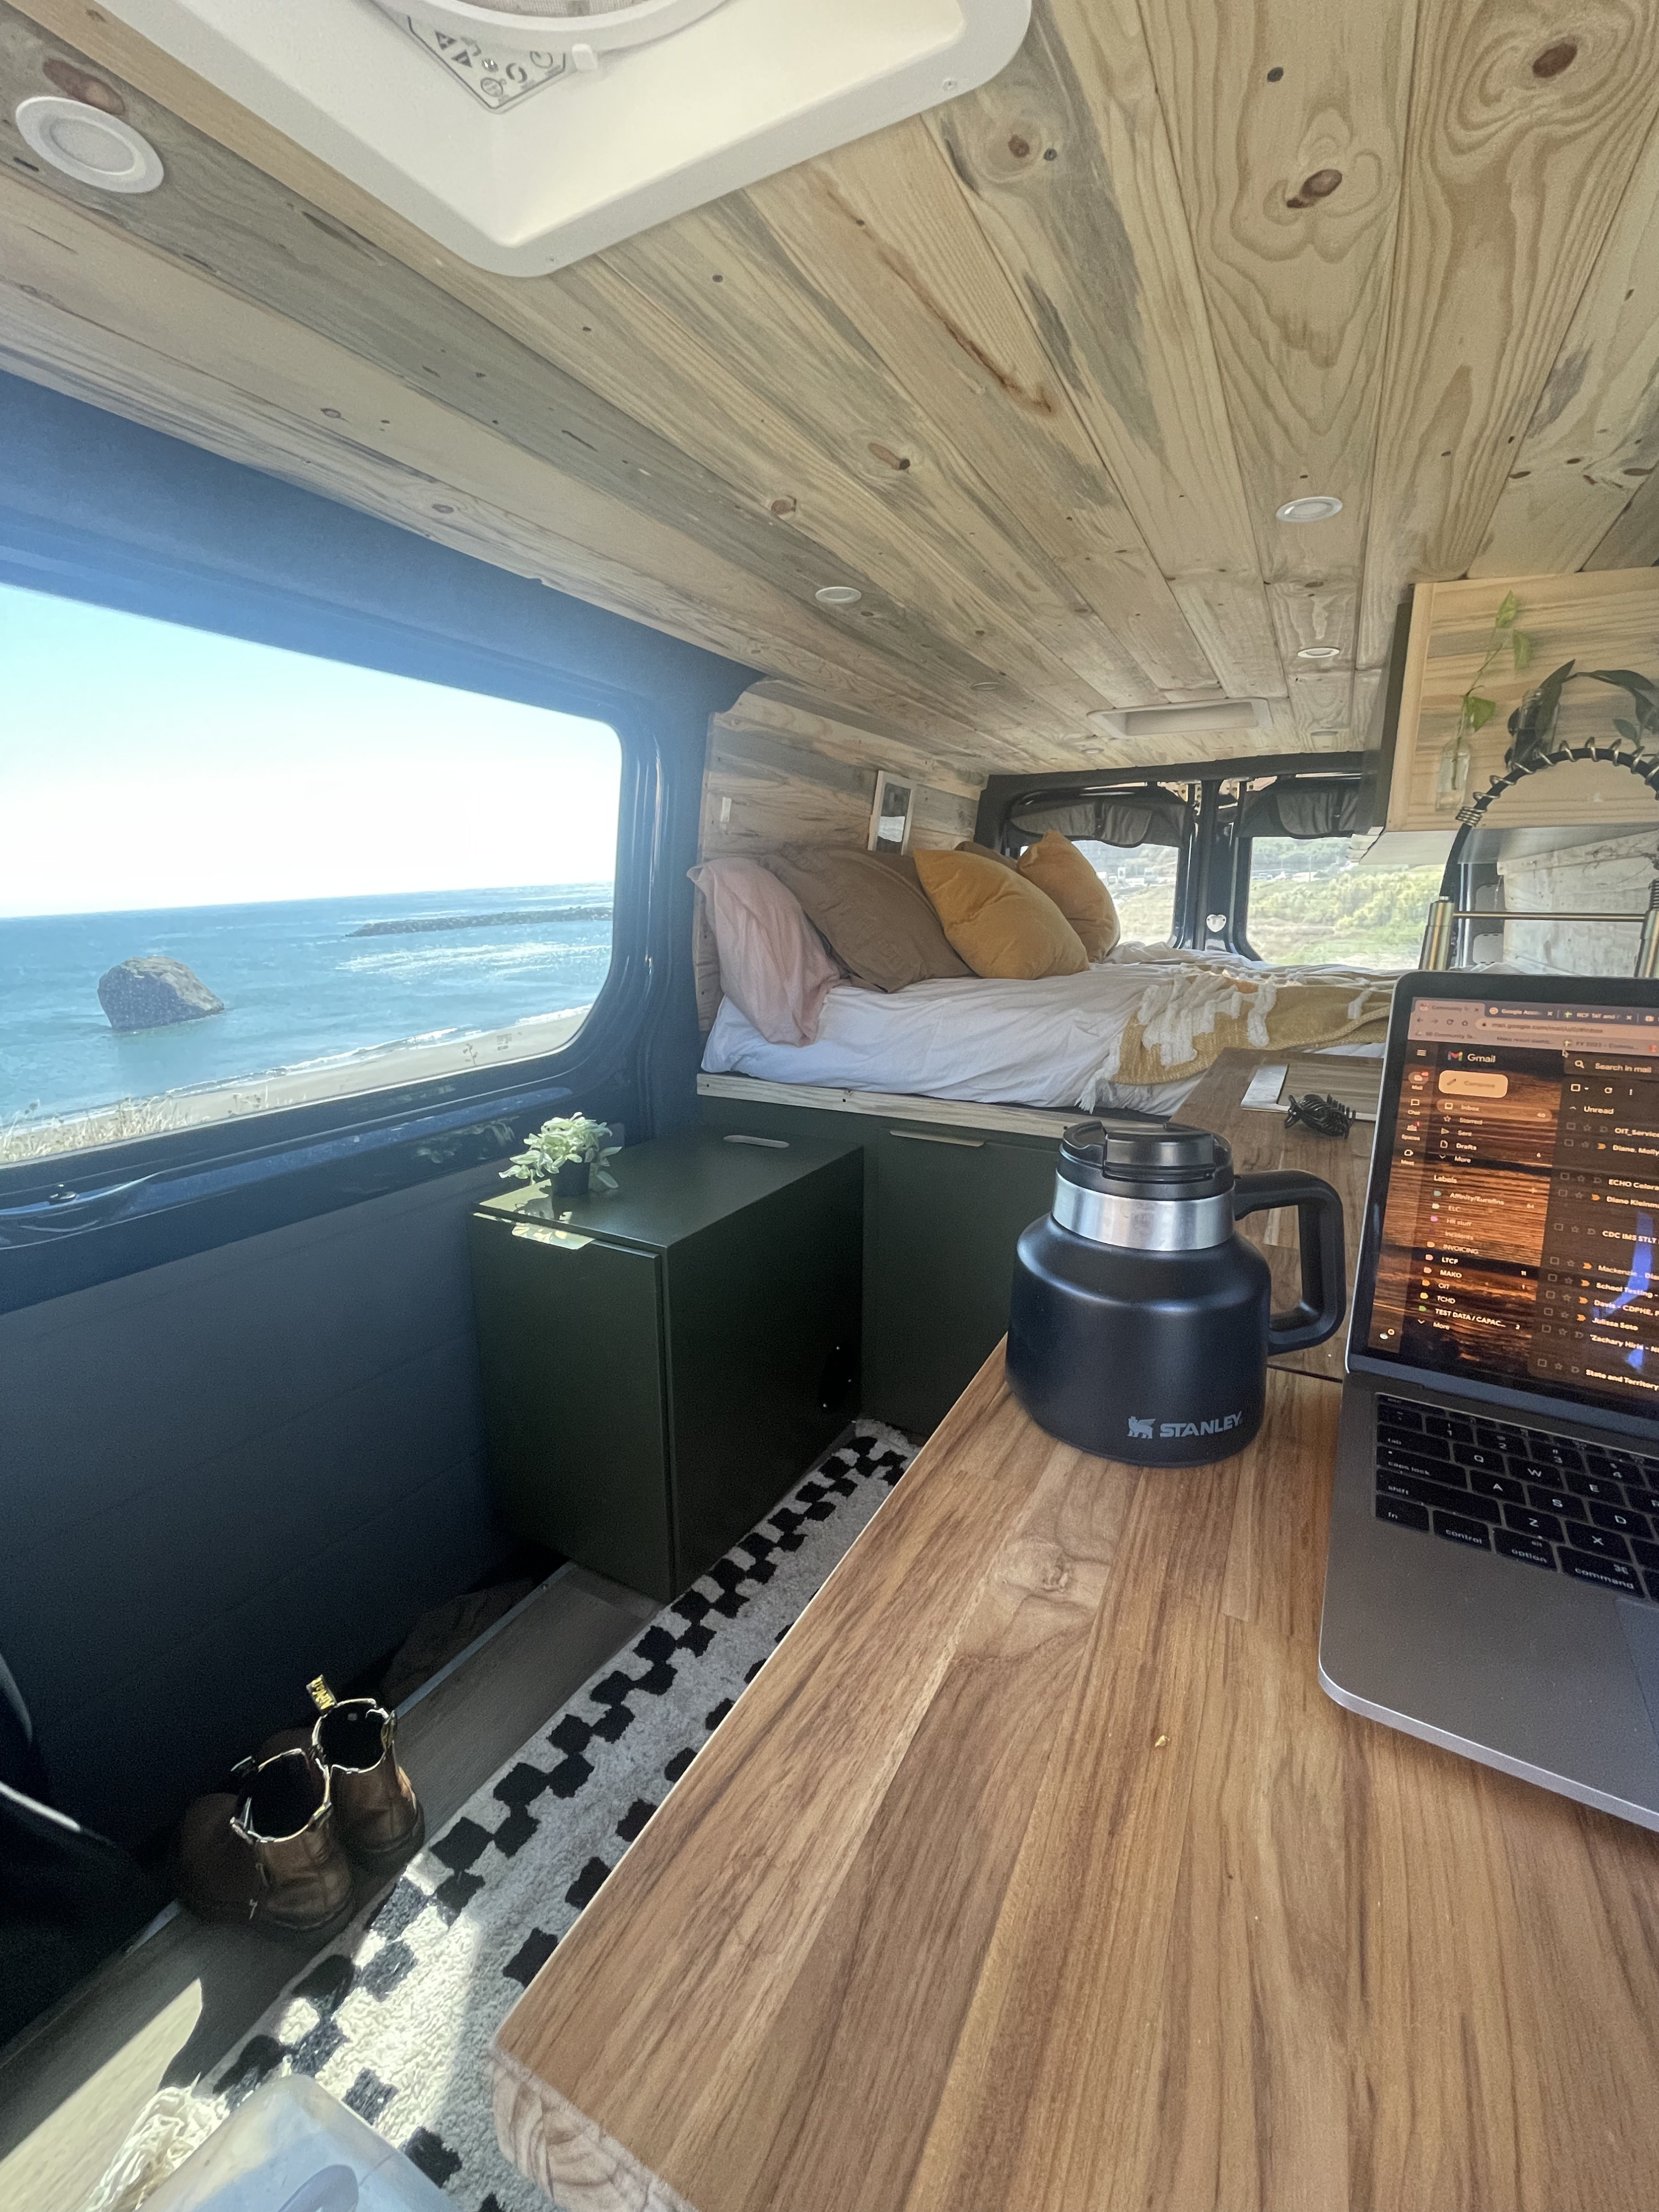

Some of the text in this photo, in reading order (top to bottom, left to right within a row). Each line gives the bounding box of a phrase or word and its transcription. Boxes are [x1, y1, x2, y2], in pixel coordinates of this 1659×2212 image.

[1467, 1053, 1496, 1063] Gmail
[1595, 1062, 1623, 1072] Search
[1460, 1104, 1480, 1112] Inbox
[1583, 1105, 1614, 1115] Unread
[1459, 1117, 1483, 1125] Starred
[1455, 1142, 1477, 1151] Drafts
[1454, 1155, 1472, 1164] More
[1433, 1175, 1458, 1183] Labels
[1608, 1179, 1632, 1187] ECHO
[1449, 1192, 1505, 1206] Affinity/Eurofins
[1445, 1231, 1474, 1240] Incidents
[1601, 1230, 1621, 1239] CDC
[1443, 1244, 1479, 1255] INVOICING
[1441, 1256, 1458, 1265] LTCF
[1439, 1269, 1462, 1279] MAKO
[1438, 1282, 1451, 1290] OIT
[1596, 1282, 1623, 1292] School
[1624, 1286, 1653, 1299] Testing
[1594, 1299, 1616, 1309] Davis
[1435, 1308, 1452, 1316] TEST
[1452, 1312, 1472, 1321] DATA
[1433, 1321, 1450, 1331] More
[1585, 1369, 1606, 1379] State
[1607, 1374, 1623, 1383] and
[1160, 1411, 1242, 1437] STANLEY
[1474, 1454, 1484, 1463] Q
[1387, 1461, 1431, 1476] caps lock
[1527, 1468, 1542, 1477] W
[1388, 1485, 1409, 1495] shift
[1493, 1483, 1503, 1491] A
[1589, 1484, 1600, 1493] E
[1552, 1499, 1563, 1507] S
[1528, 1517, 1540, 1527] Z
[1614, 1515, 1627, 1525] D
[1446, 1529, 1483, 1544] control
[1592, 1535, 1604, 1546] X
[1511, 1548, 1547, 1563] option
[1574, 1568, 1635, 1590] command
